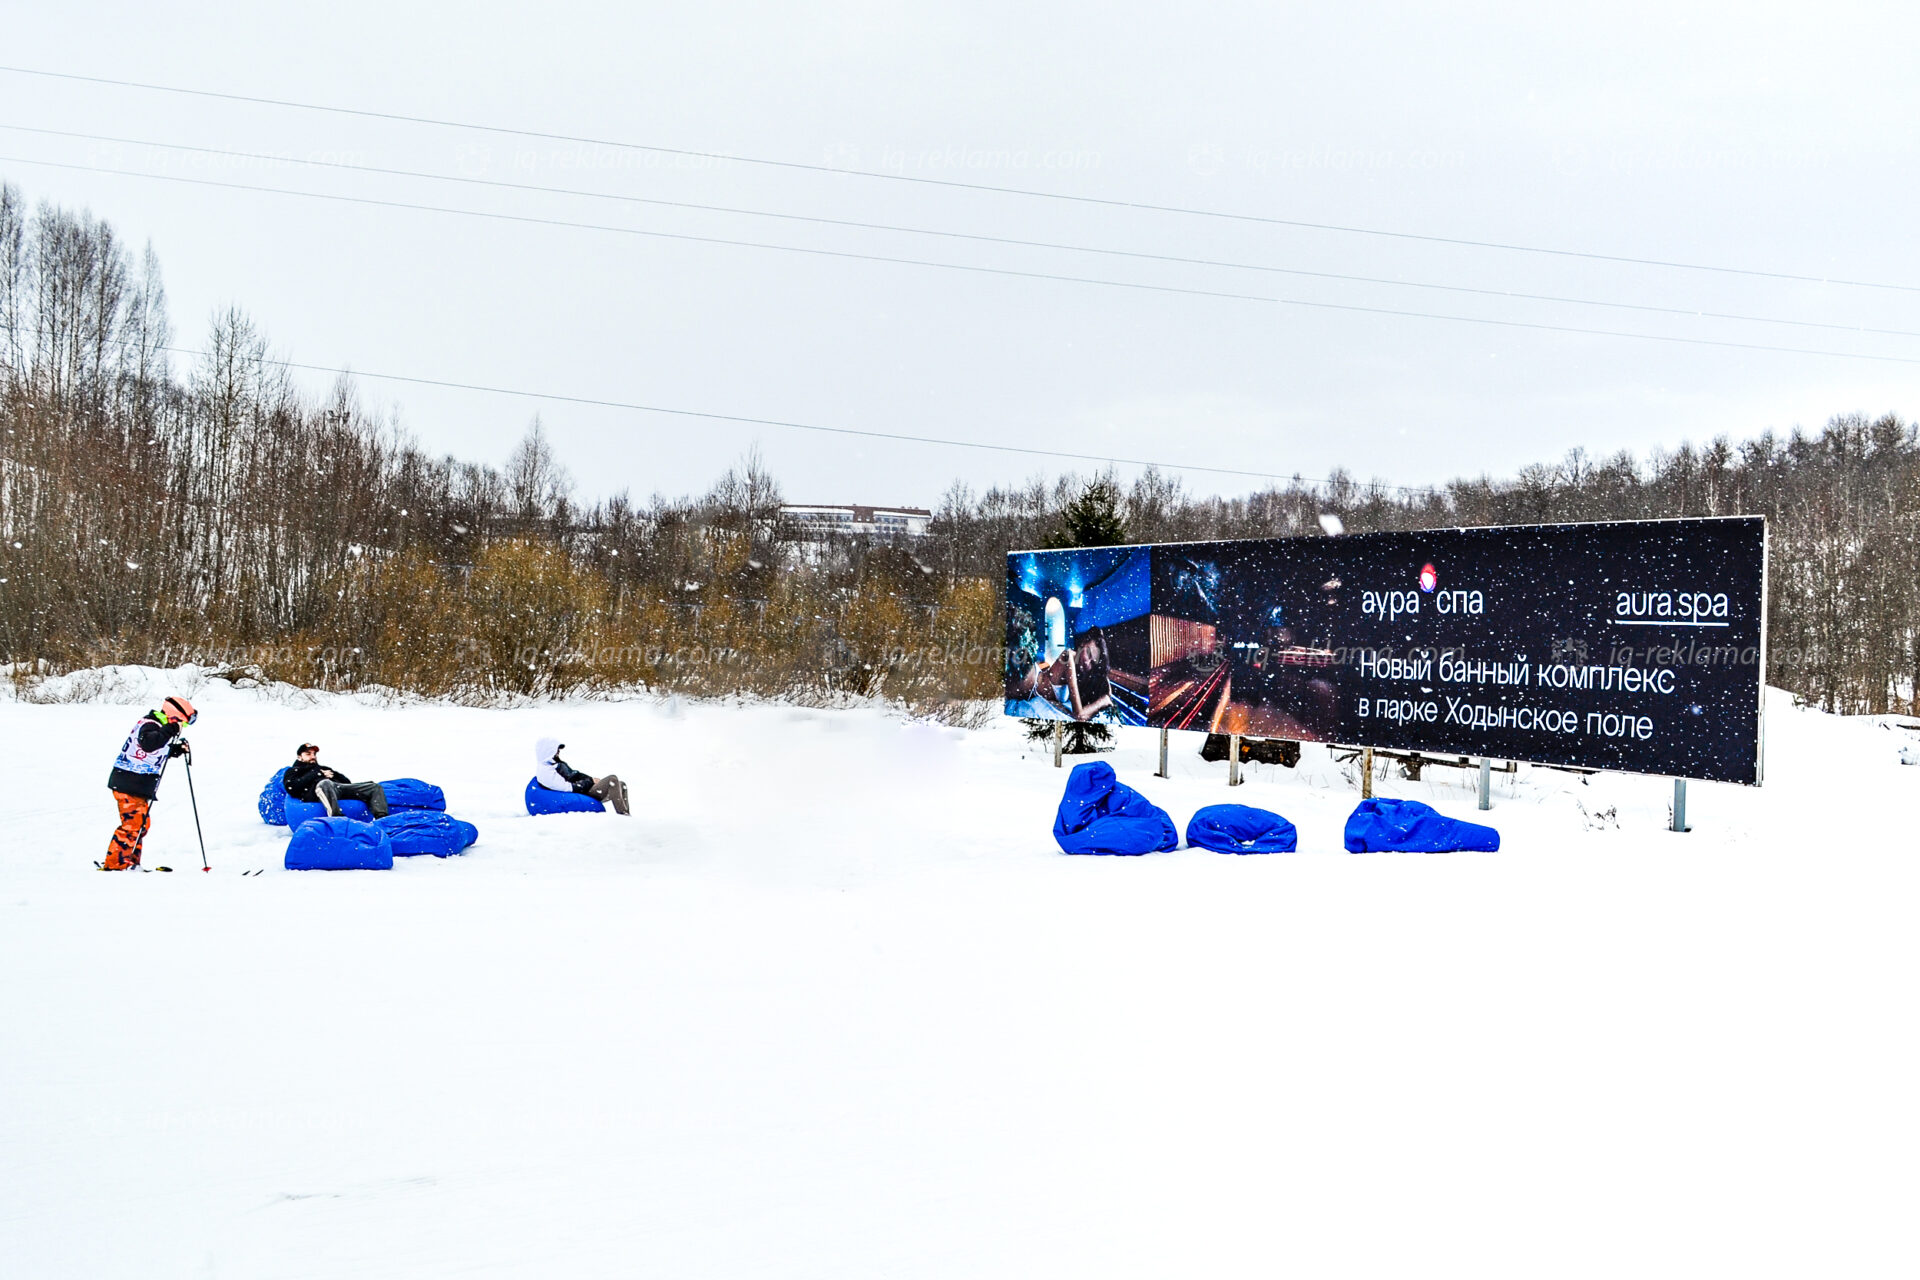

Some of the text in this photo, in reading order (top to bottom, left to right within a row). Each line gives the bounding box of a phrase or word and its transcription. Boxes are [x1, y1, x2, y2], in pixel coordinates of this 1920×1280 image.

[1361, 588, 1484, 622] аура спа
[1615, 590, 1730, 627] aura.spa
[1360, 651, 1676, 694] Новый банный комплекс
[1358, 696, 1654, 739] в парке Ходынское поле
